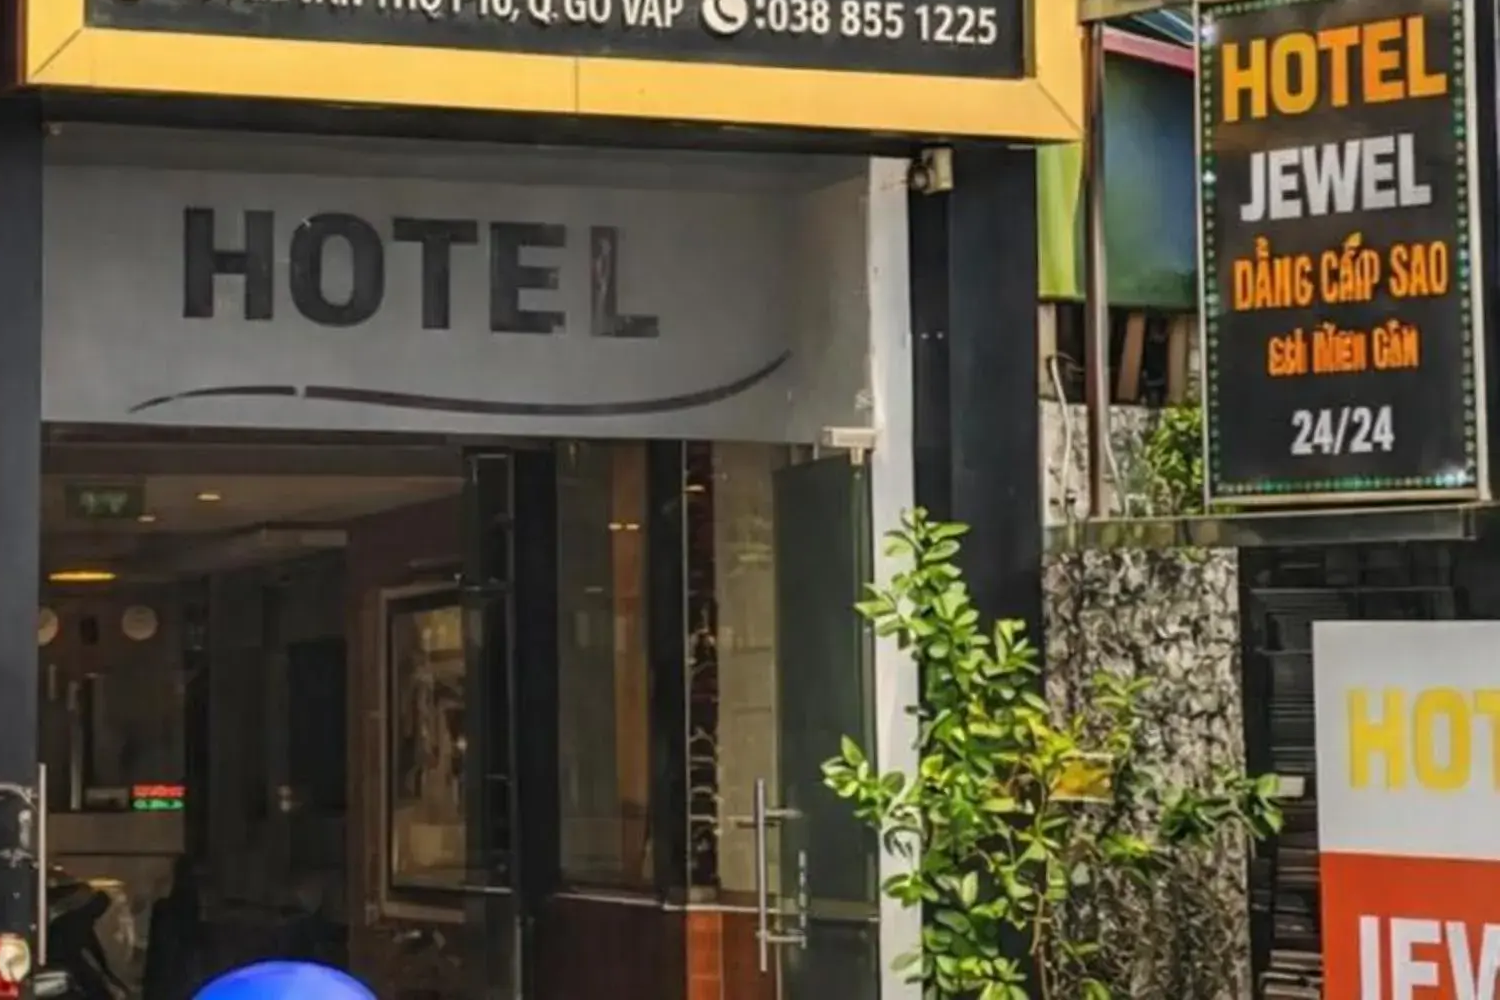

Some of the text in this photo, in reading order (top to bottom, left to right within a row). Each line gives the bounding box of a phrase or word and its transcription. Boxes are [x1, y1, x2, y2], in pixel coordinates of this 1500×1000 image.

[915, 4, 998, 45] 1225
[1222, 14, 1448, 123] HOTEL
[1240, 133, 1433, 222] JEWEL
[181, 205, 660, 338] HOTEL
[1390, 240, 1448, 298] SAO
[1290, 405, 1395, 456] 24/24
